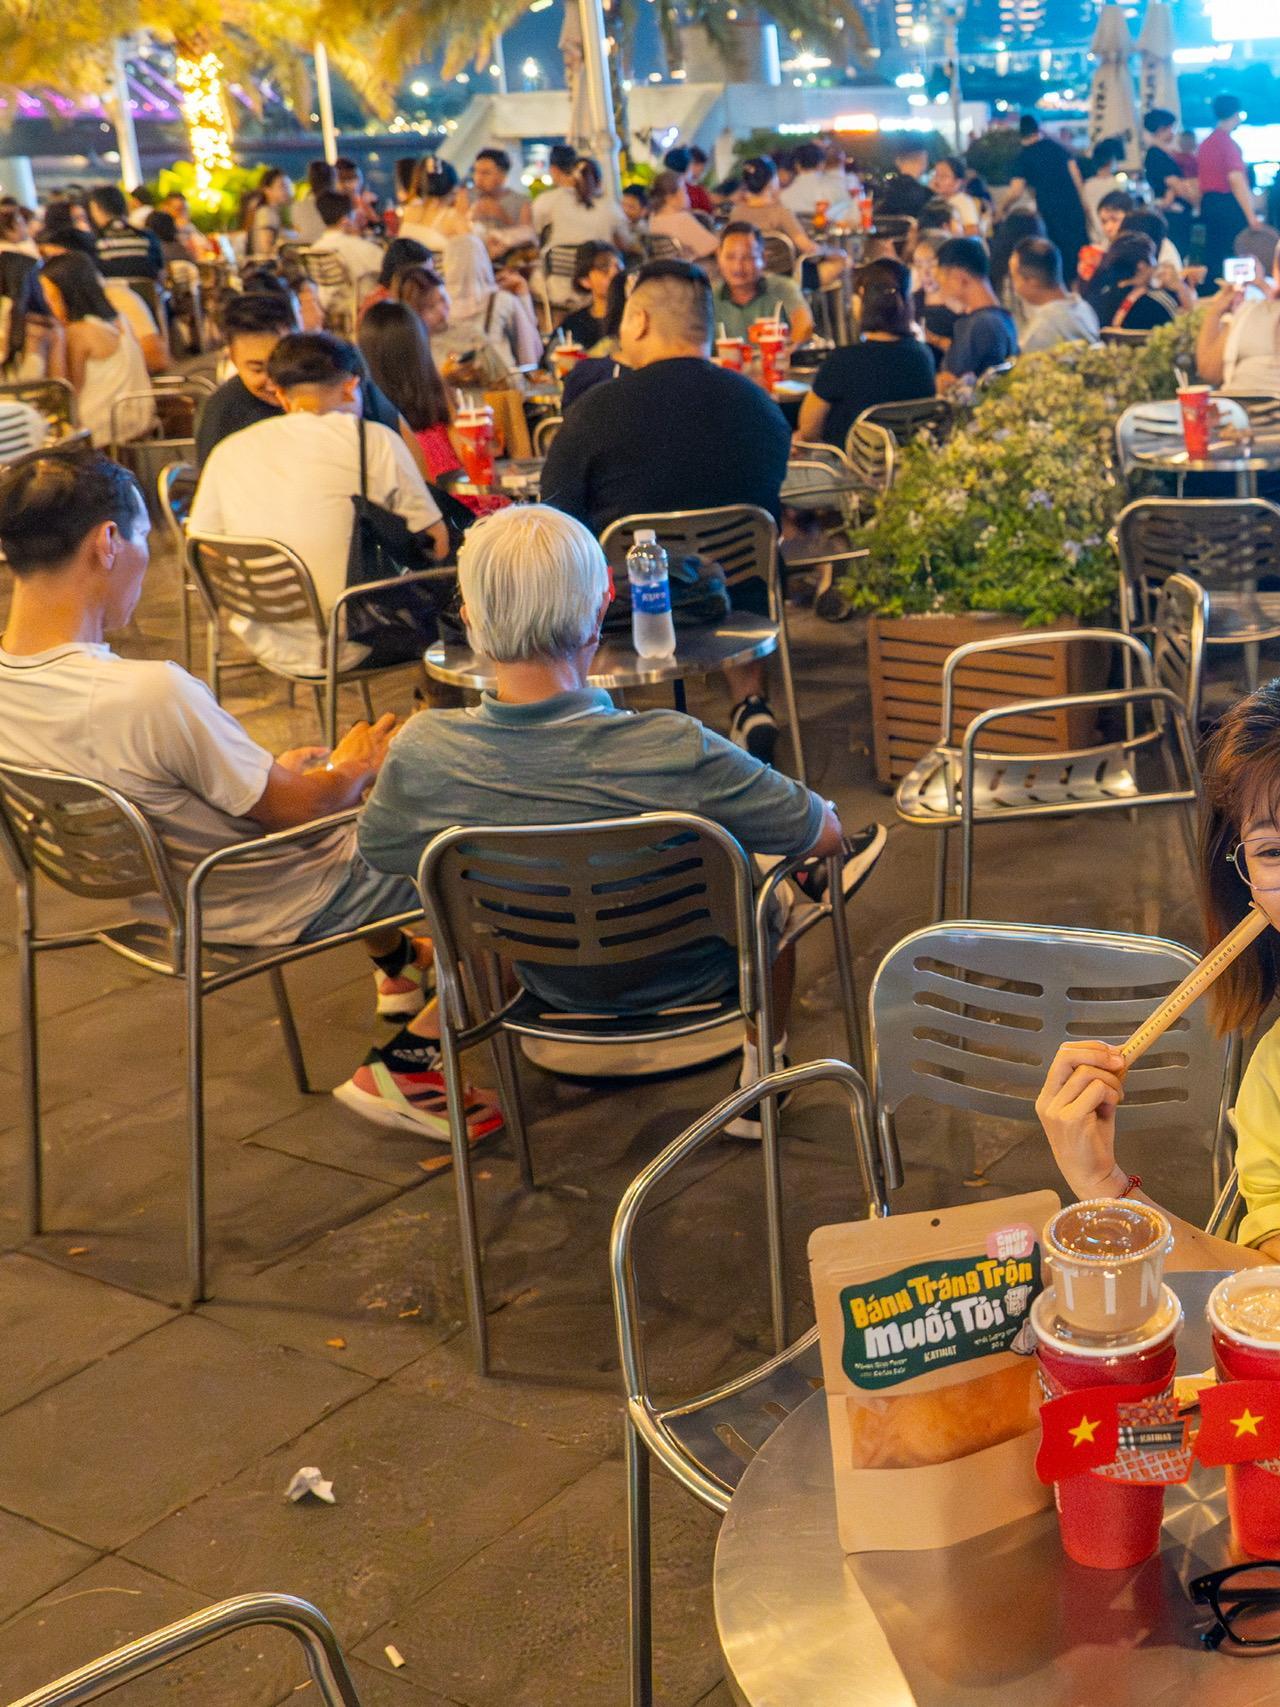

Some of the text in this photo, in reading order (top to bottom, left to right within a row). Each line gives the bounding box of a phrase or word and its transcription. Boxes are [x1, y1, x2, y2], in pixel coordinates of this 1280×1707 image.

[907, 1269, 982, 1305] Tráng
[975, 1259, 1034, 1289] Trộn
[951, 1296, 1005, 1334] Tỏi
